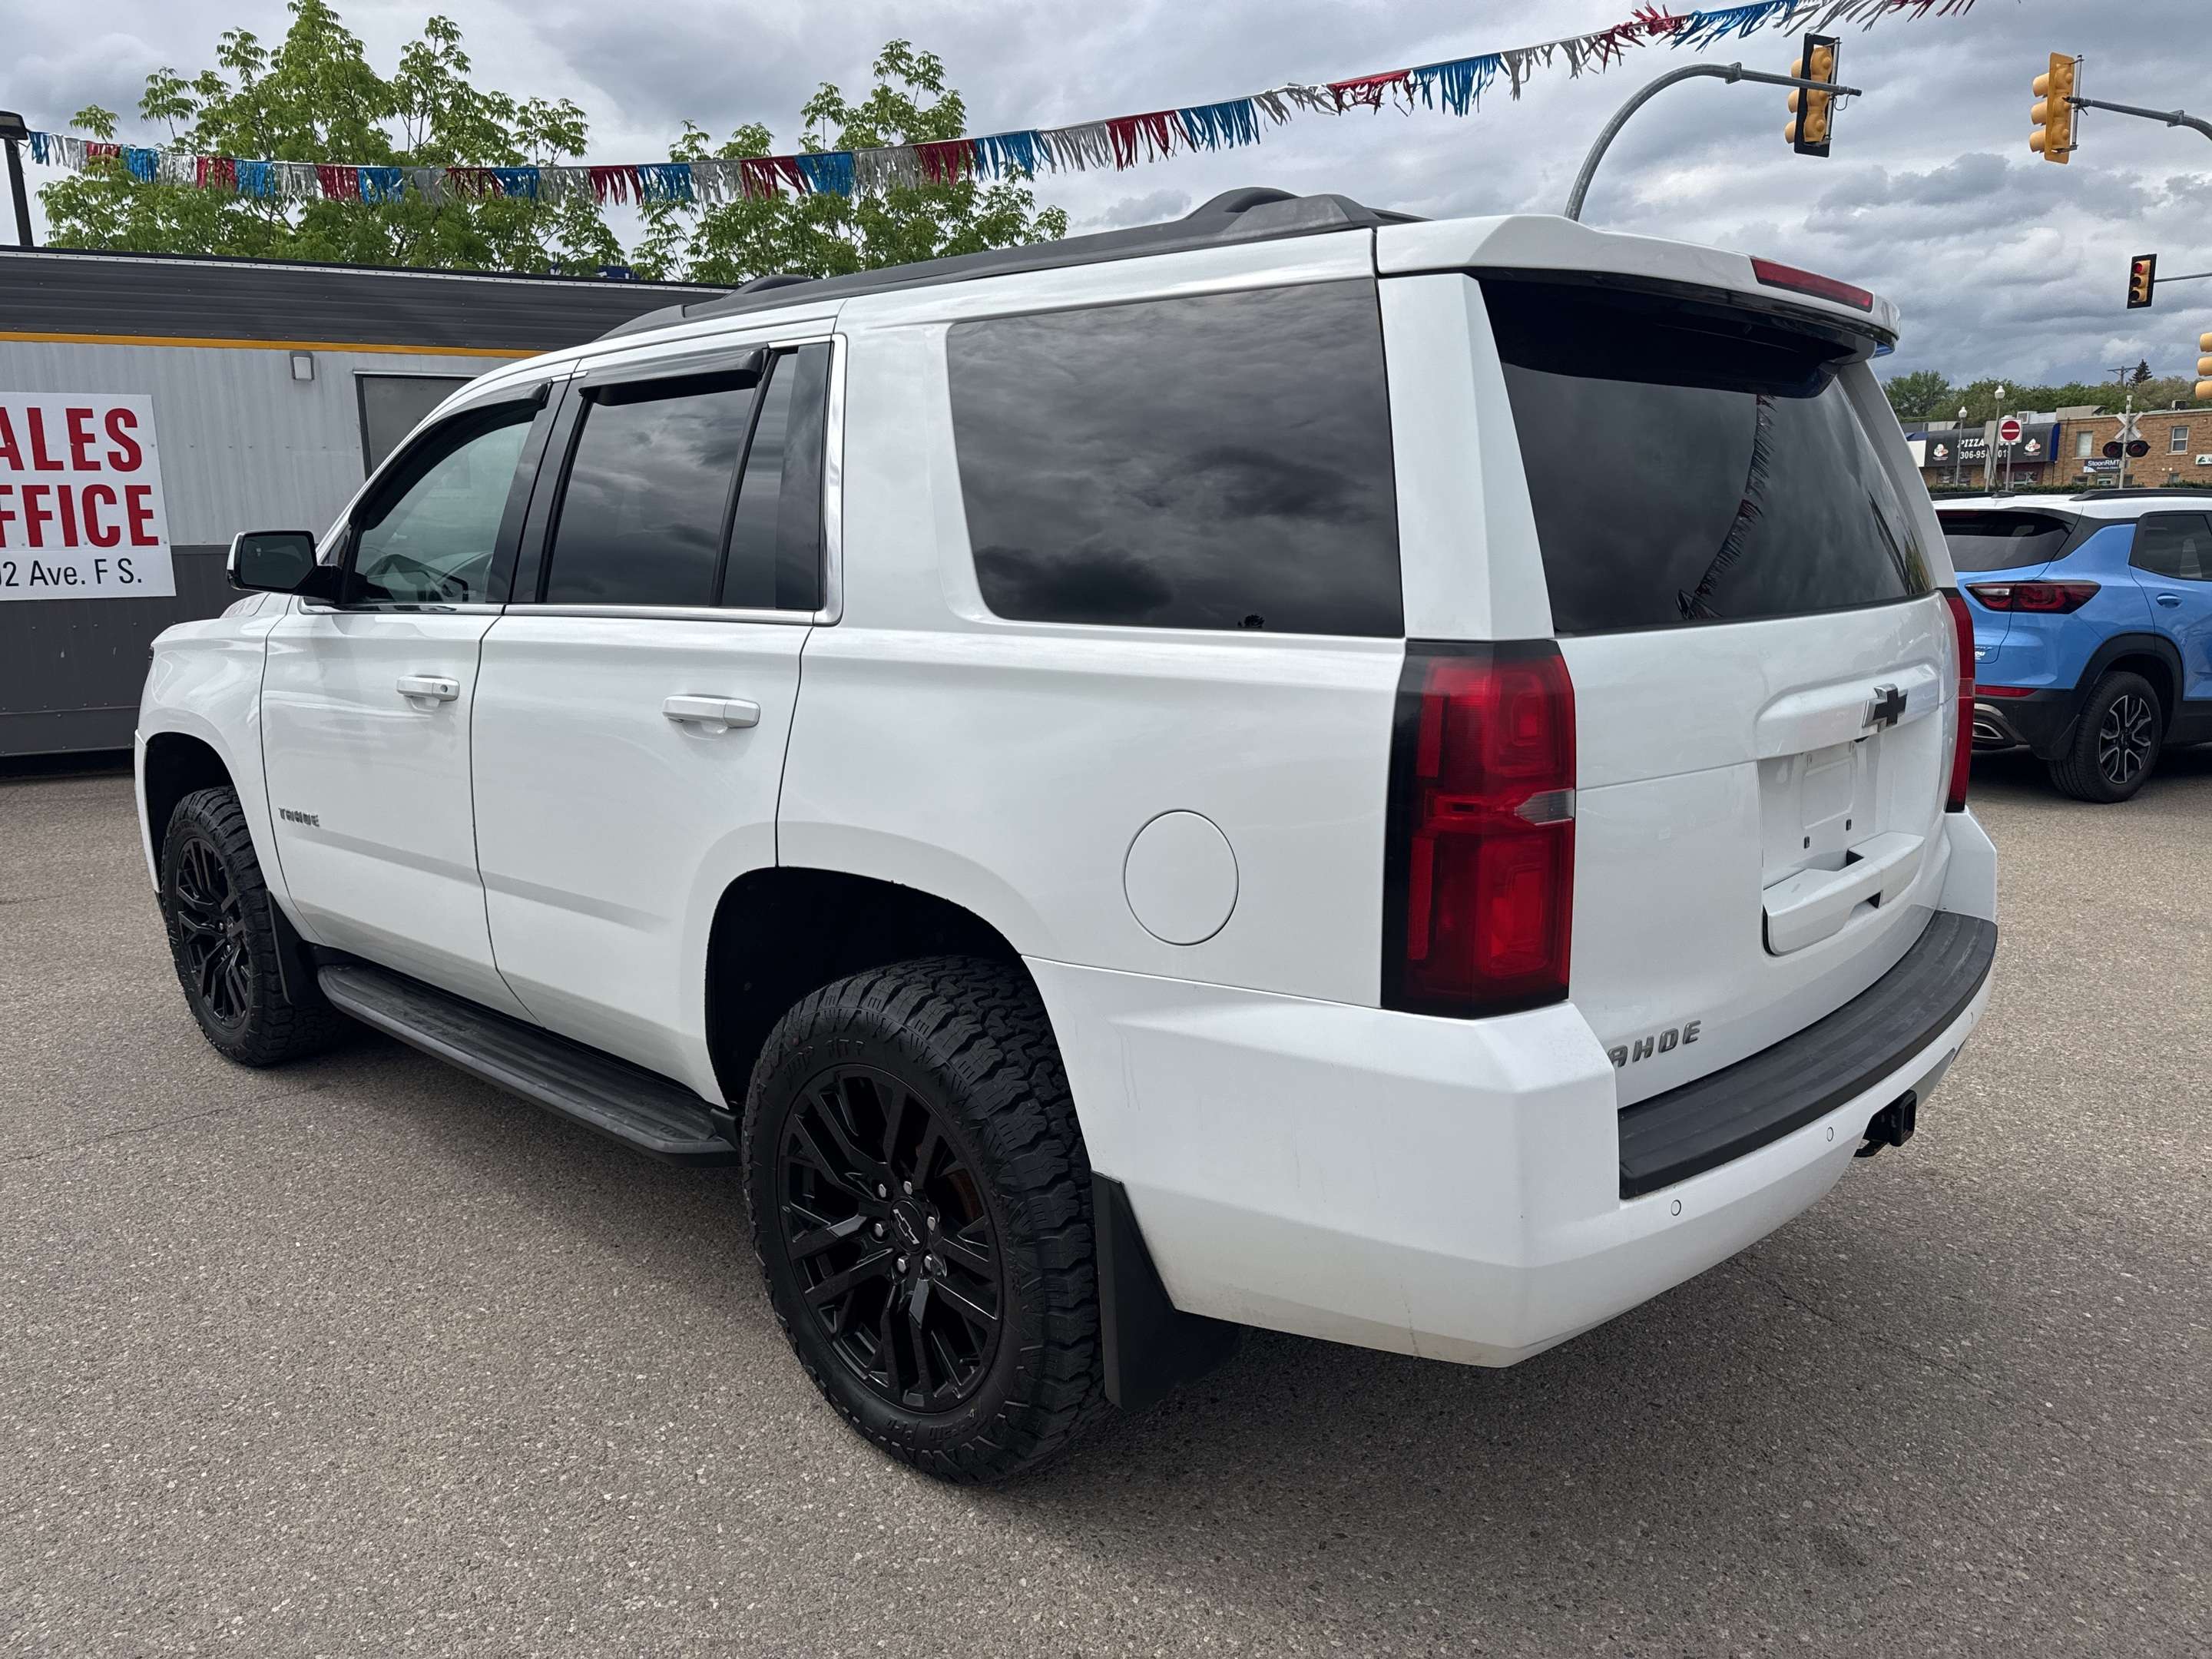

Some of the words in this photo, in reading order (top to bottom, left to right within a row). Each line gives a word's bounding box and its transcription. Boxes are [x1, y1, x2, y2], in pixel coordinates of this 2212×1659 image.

[1957, 439, 1985, 448] PIZZA
[29, 560, 85, 587] Ave.
[94, 558, 108, 584] F
[118, 558, 142, 584] S.
[278, 807, 320, 827] TAHOE
